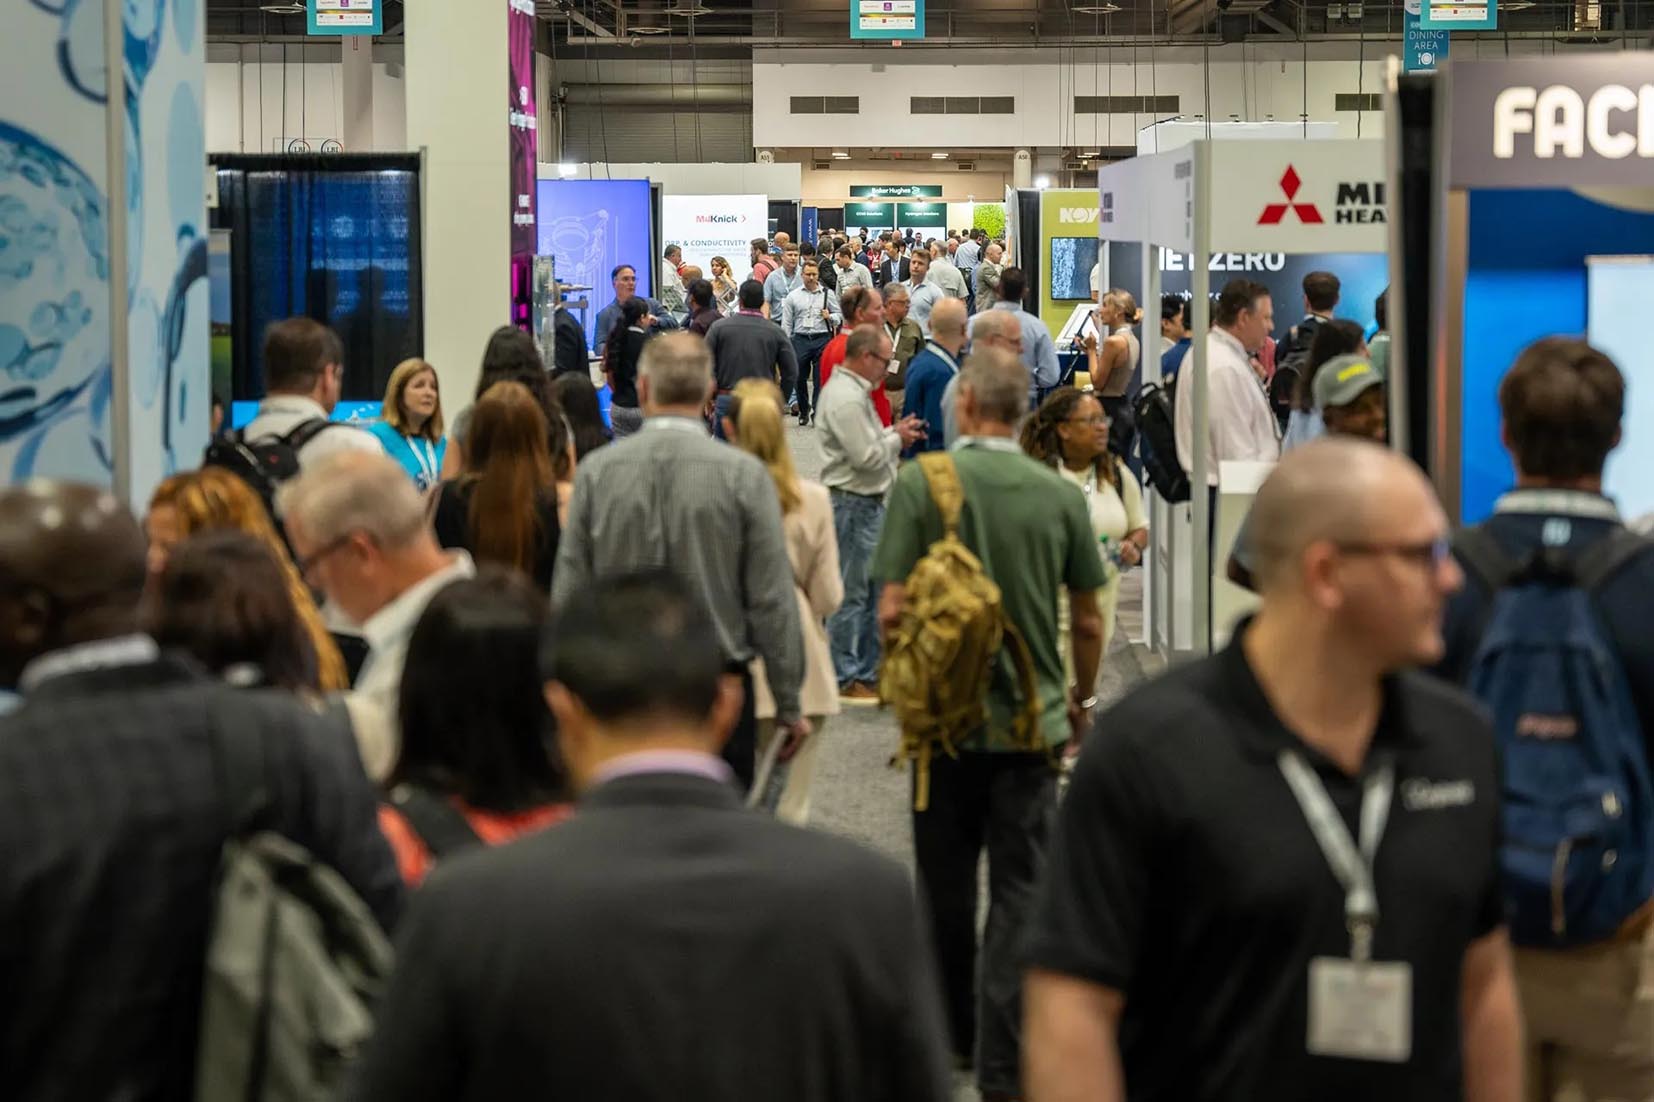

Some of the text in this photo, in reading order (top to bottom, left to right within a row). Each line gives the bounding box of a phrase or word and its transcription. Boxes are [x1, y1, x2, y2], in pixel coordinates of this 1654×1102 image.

[1409, 31, 1444, 39] DINING
[1414, 41, 1438, 50] AREA
[889, 187, 911, 195] Hughes
[1060, 208, 1100, 223] NOV
[1336, 209, 1387, 224] HEA
[1208, 252, 1286, 271] ZERO
